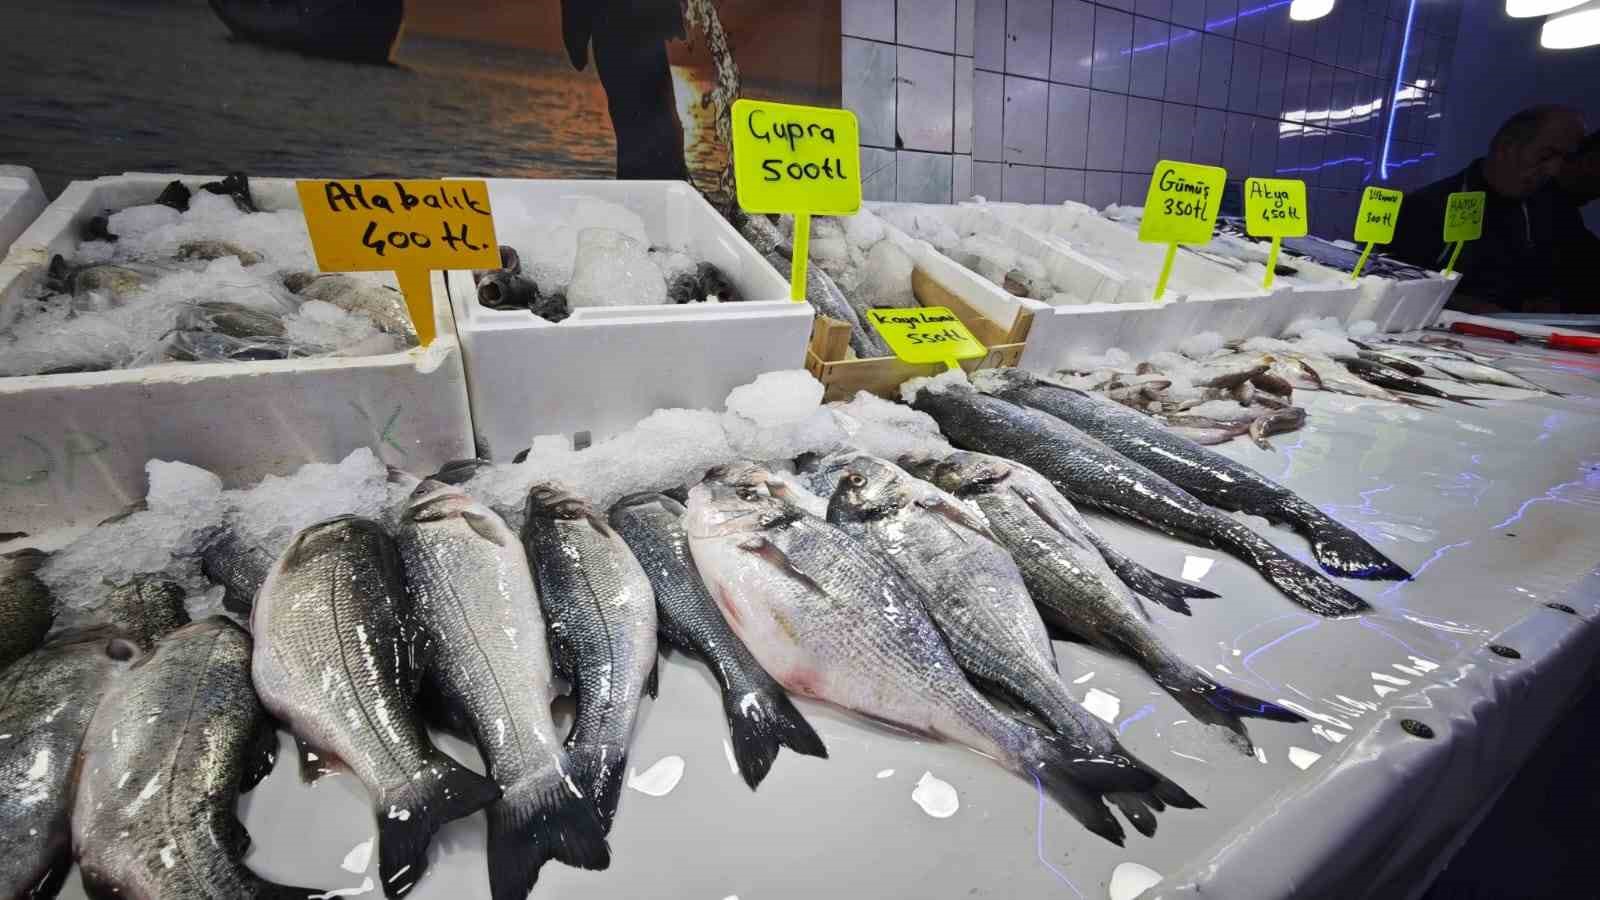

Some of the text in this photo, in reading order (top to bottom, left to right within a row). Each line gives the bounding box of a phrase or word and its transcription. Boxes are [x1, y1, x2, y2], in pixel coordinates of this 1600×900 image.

[1159, 169, 1210, 200] Gümüş
[1250, 181, 1289, 208] Akya
[362, 221, 431, 256] 400
